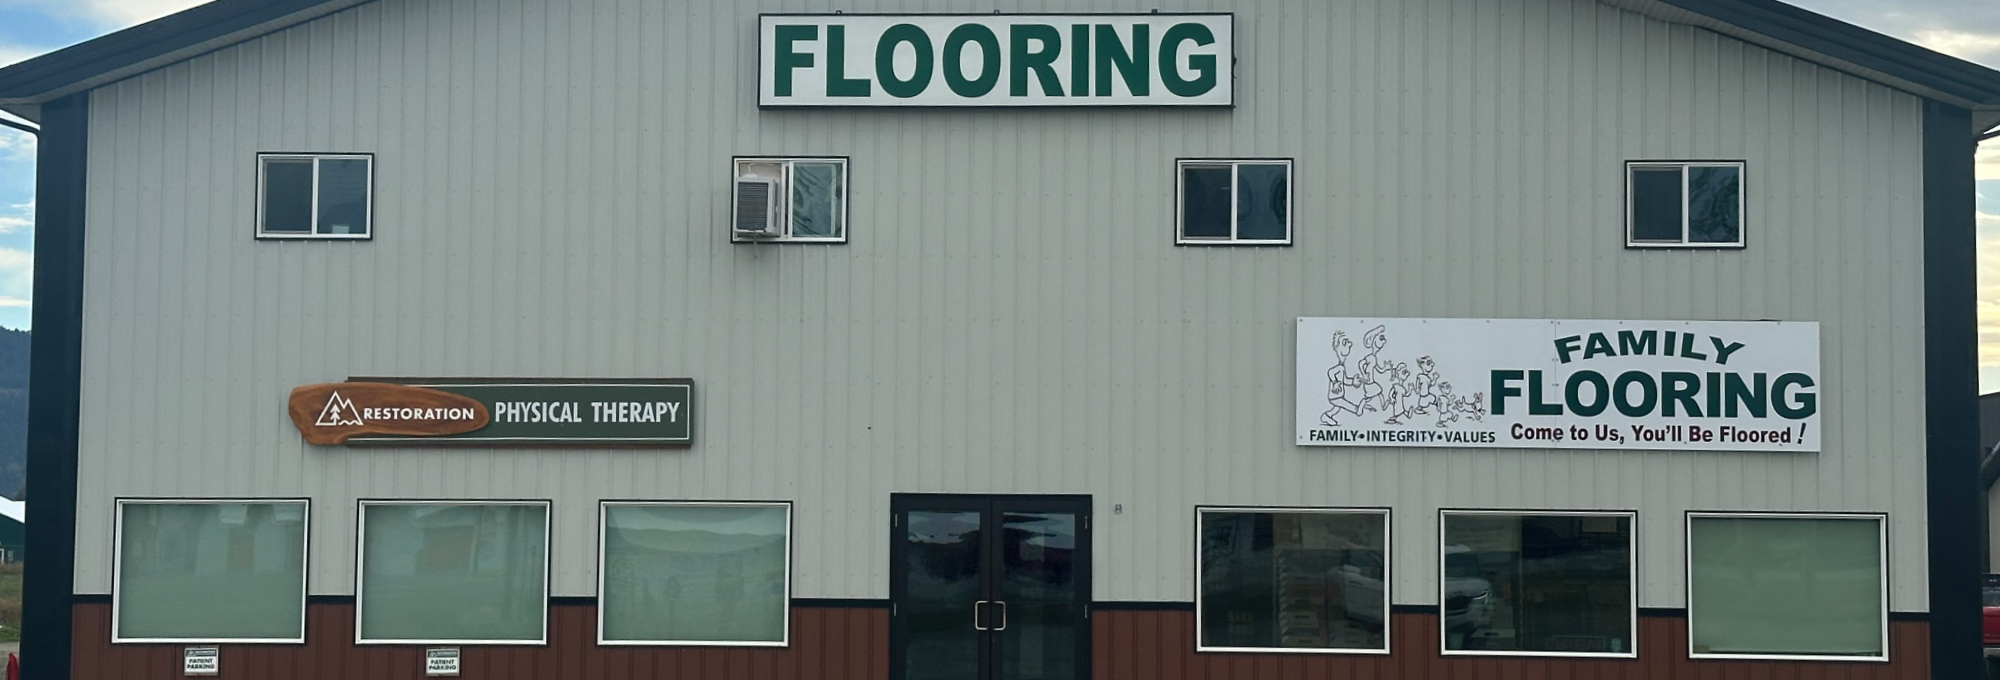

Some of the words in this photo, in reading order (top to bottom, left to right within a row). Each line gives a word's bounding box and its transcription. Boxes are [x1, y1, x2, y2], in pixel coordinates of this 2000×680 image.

[774, 22, 1217, 98] FLOORING
[1554, 330, 1746, 365] FAMILY
[363, 407, 475, 421] RESTORATION
[494, 401, 582, 423] PHYSICAL
[591, 401, 680, 423] THERAPY
[1490, 369, 1817, 420] FLOORING
[1510, 422, 1564, 441] Come
[1570, 424, 1589, 441] to
[1595, 424, 1625, 444] Us,
[1689, 425, 1713, 443] Be
